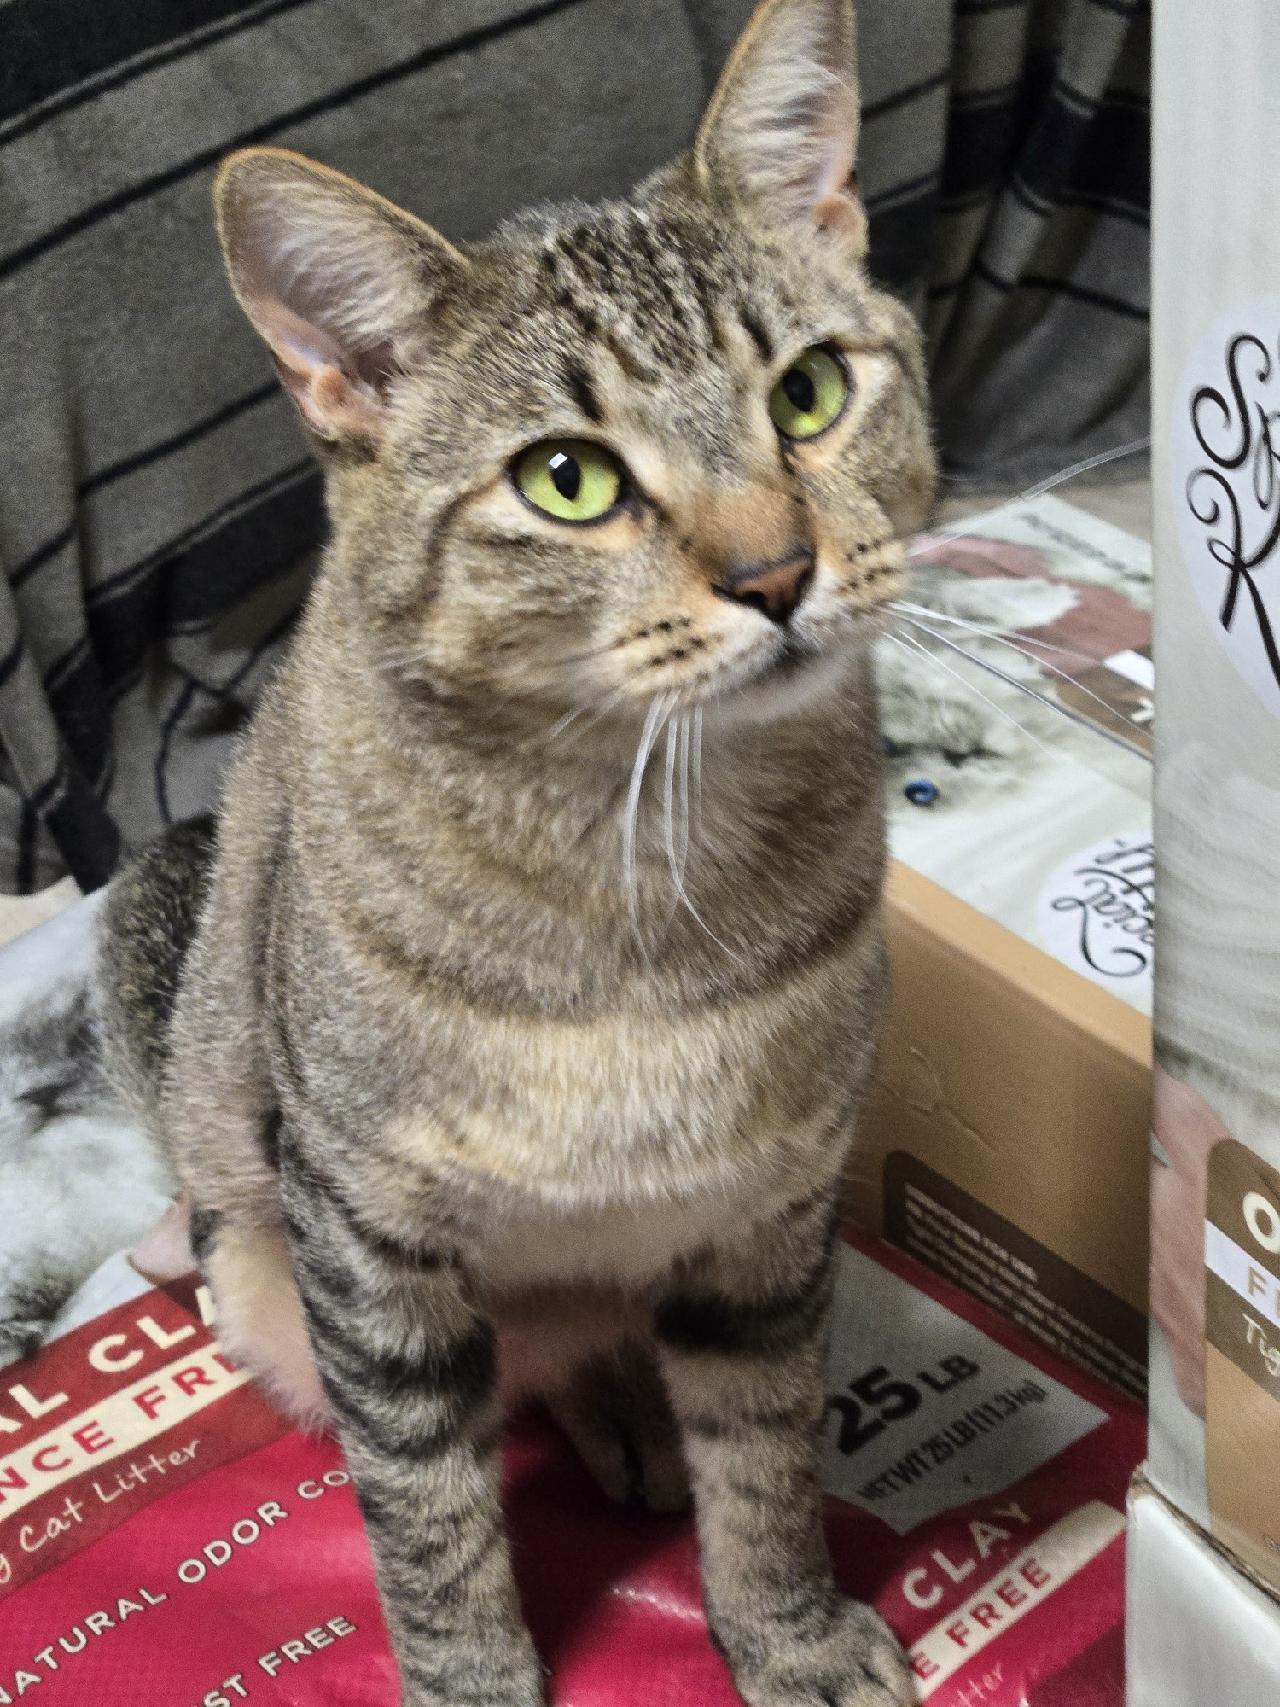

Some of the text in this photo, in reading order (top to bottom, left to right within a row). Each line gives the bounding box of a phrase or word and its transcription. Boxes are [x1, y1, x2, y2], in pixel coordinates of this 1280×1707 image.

[134, 1353, 237, 1420] FR
[826, 1355, 980, 1455] 25 LB
[20, 1440, 201, 1552] Cat Litter
[177, 1500, 288, 1584] ODOR
[902, 1502, 1031, 1609] CLAY
[945, 1557, 1051, 1648] FREE
[193, 1616, 357, 1707] ST FREE
